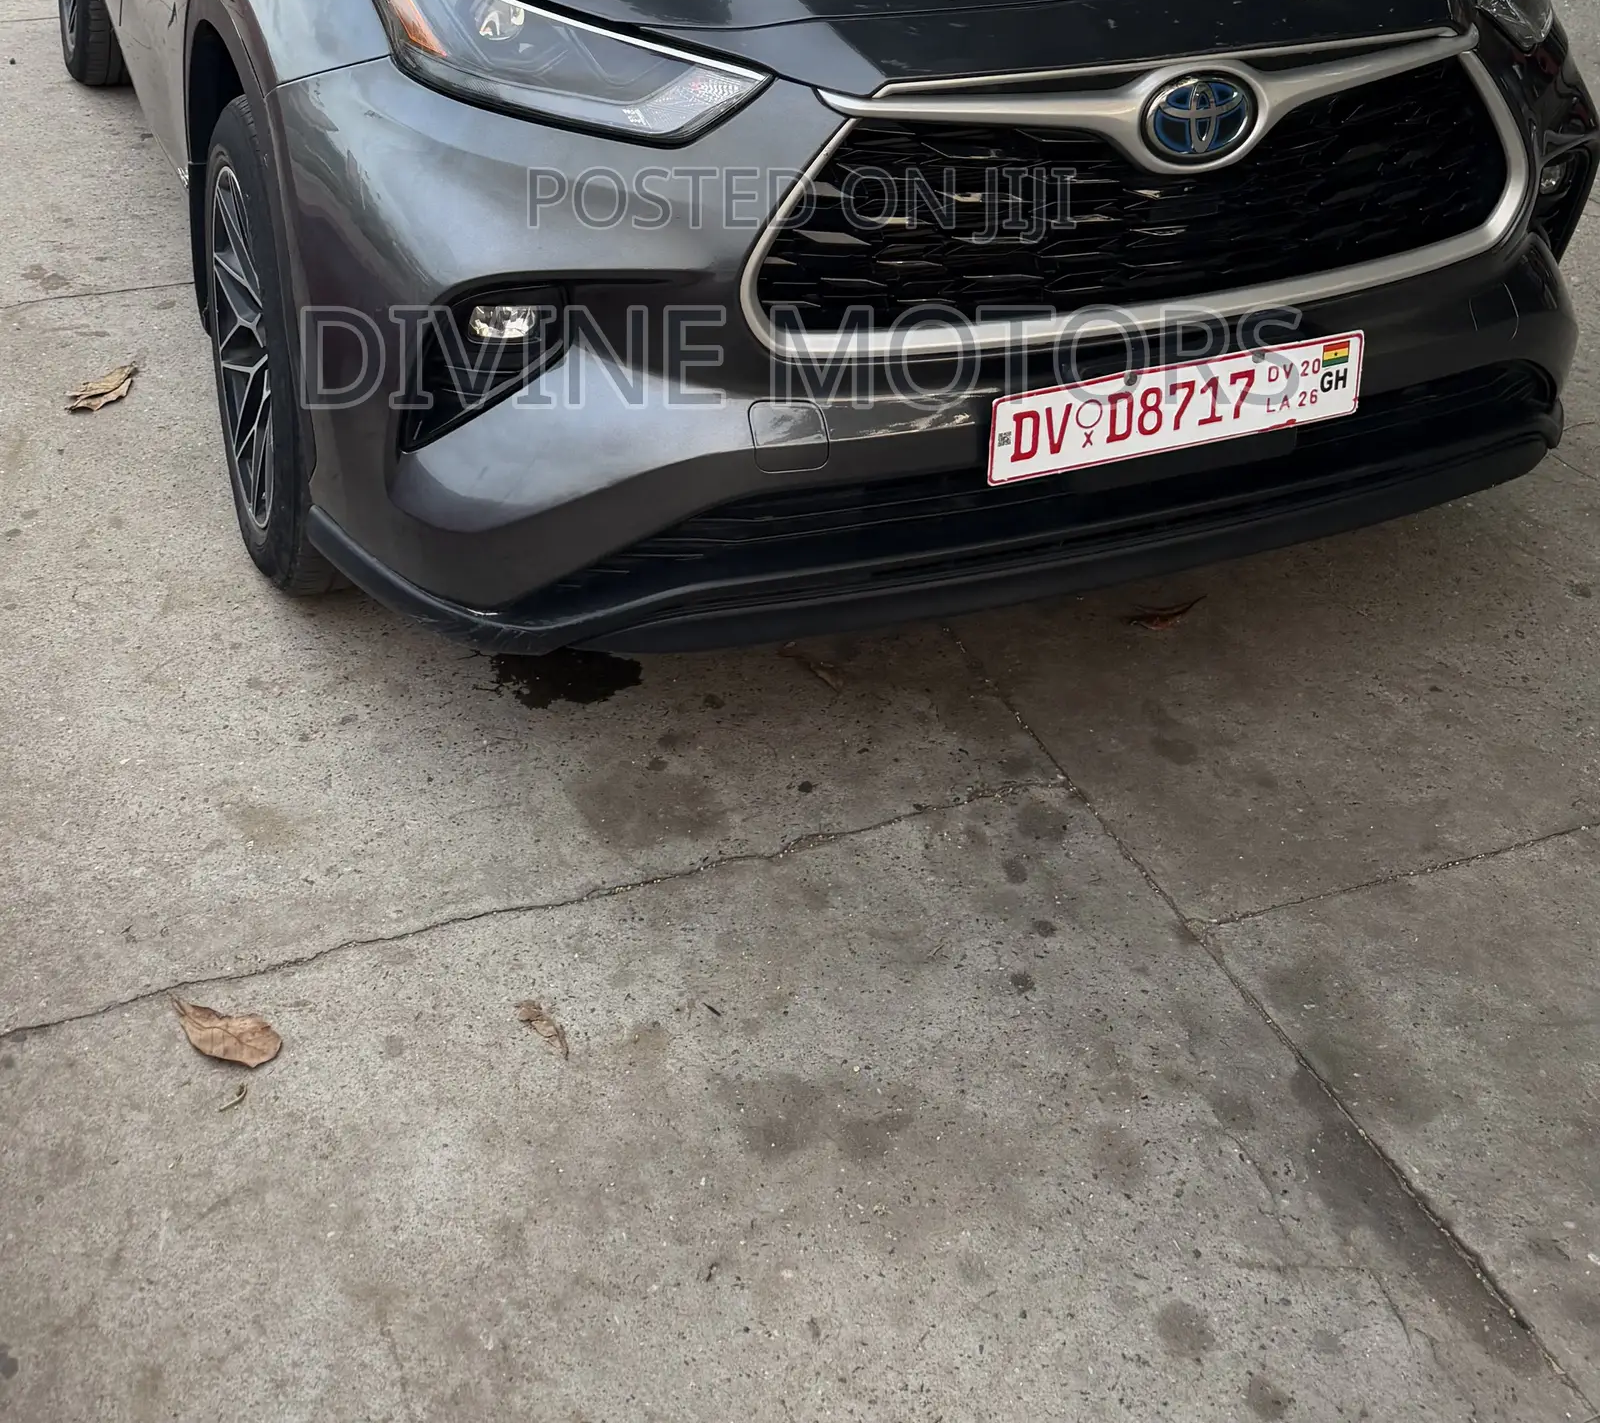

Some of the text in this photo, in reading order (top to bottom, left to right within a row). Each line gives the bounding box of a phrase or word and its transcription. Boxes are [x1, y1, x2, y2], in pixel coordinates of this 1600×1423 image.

[1268, 358, 1321, 382] DV 20
[1320, 368, 1348, 393] GH
[1266, 389, 1318, 413] LA 26
[1011, 369, 1255, 462] DV D8717
